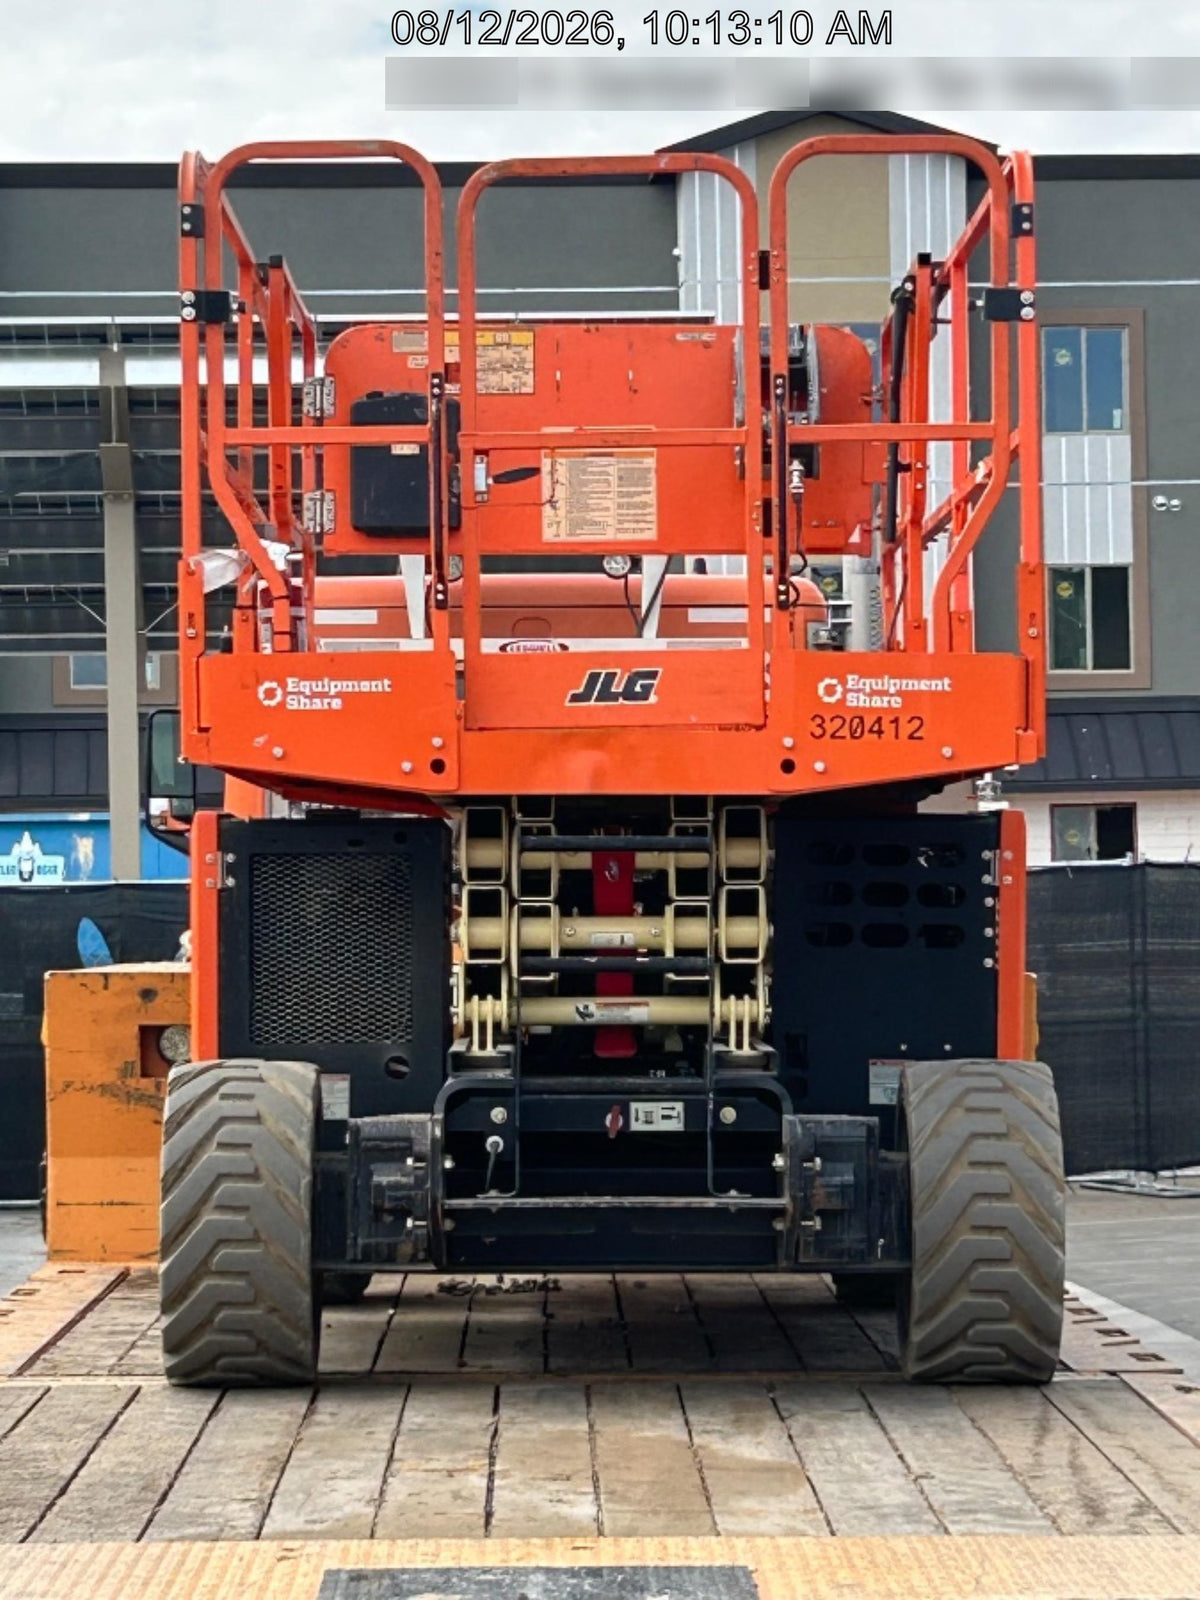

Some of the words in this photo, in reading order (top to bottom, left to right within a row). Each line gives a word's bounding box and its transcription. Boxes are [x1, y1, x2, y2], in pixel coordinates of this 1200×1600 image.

[286, 677, 392, 695] Equipment
[564, 667, 663, 706] JLG
[846, 674, 952, 693] Equipment
[286, 695, 342, 710] Share
[846, 692, 902, 708] Share
[810, 713, 924, 741] 320412
